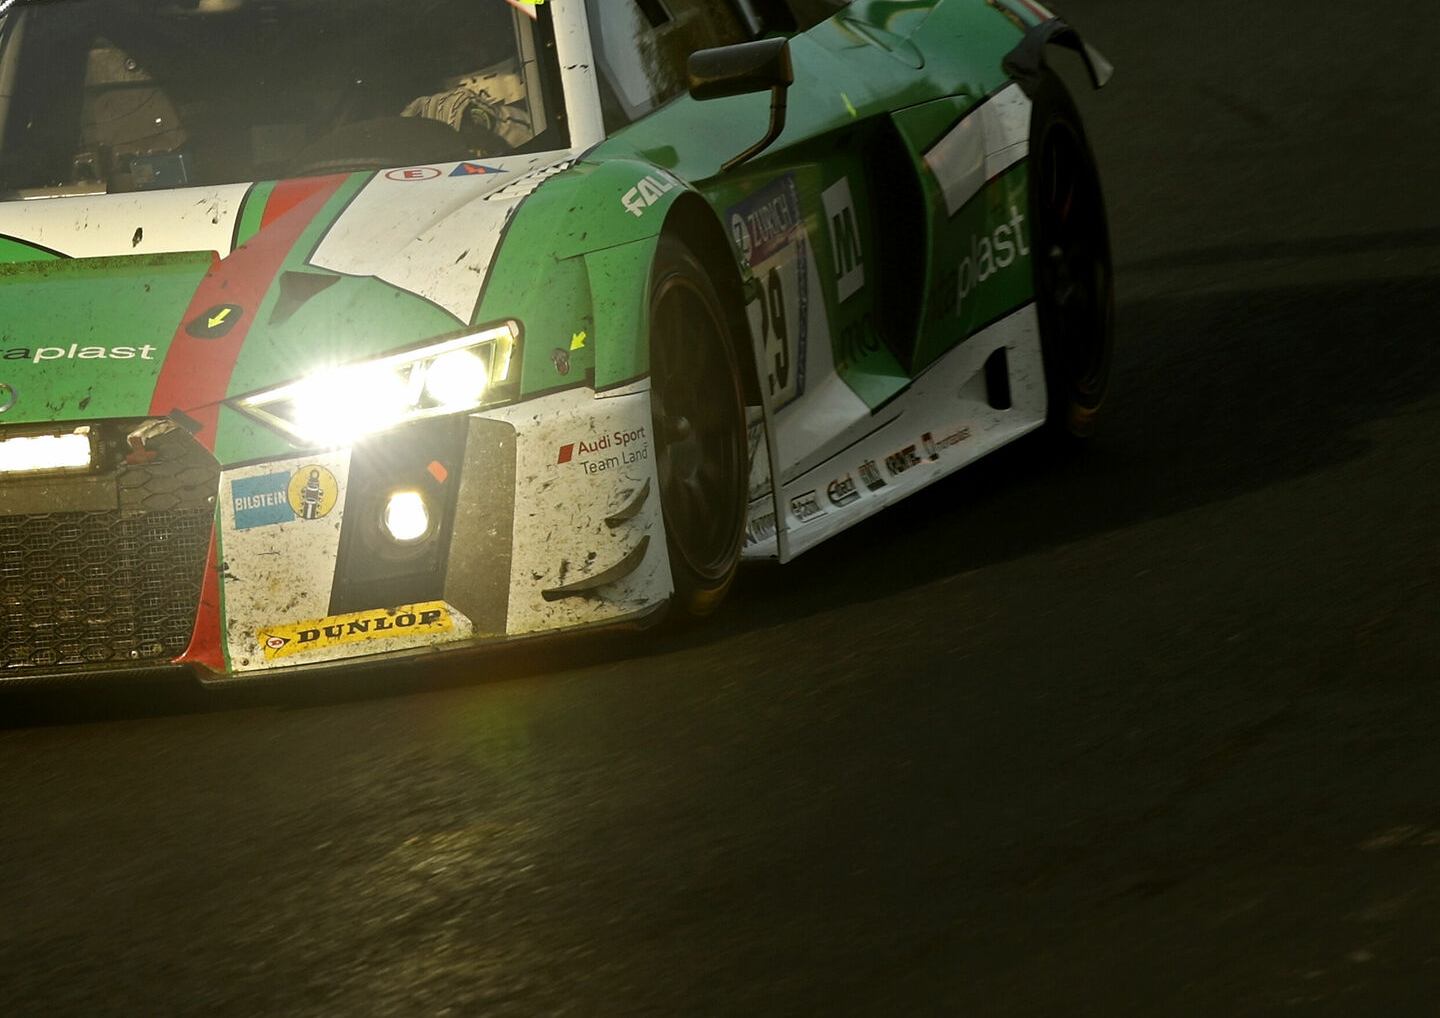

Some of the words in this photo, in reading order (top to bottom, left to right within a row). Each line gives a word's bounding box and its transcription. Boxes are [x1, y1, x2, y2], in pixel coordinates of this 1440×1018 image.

[578, 434, 611, 455] Audi
[614, 427, 646, 446] Sport
[580, 455, 620, 475] Team
[622, 445, 649, 466] Land
[234, 489, 288, 512] BILSTEIN
[297, 609, 442, 644] DUNLOP
